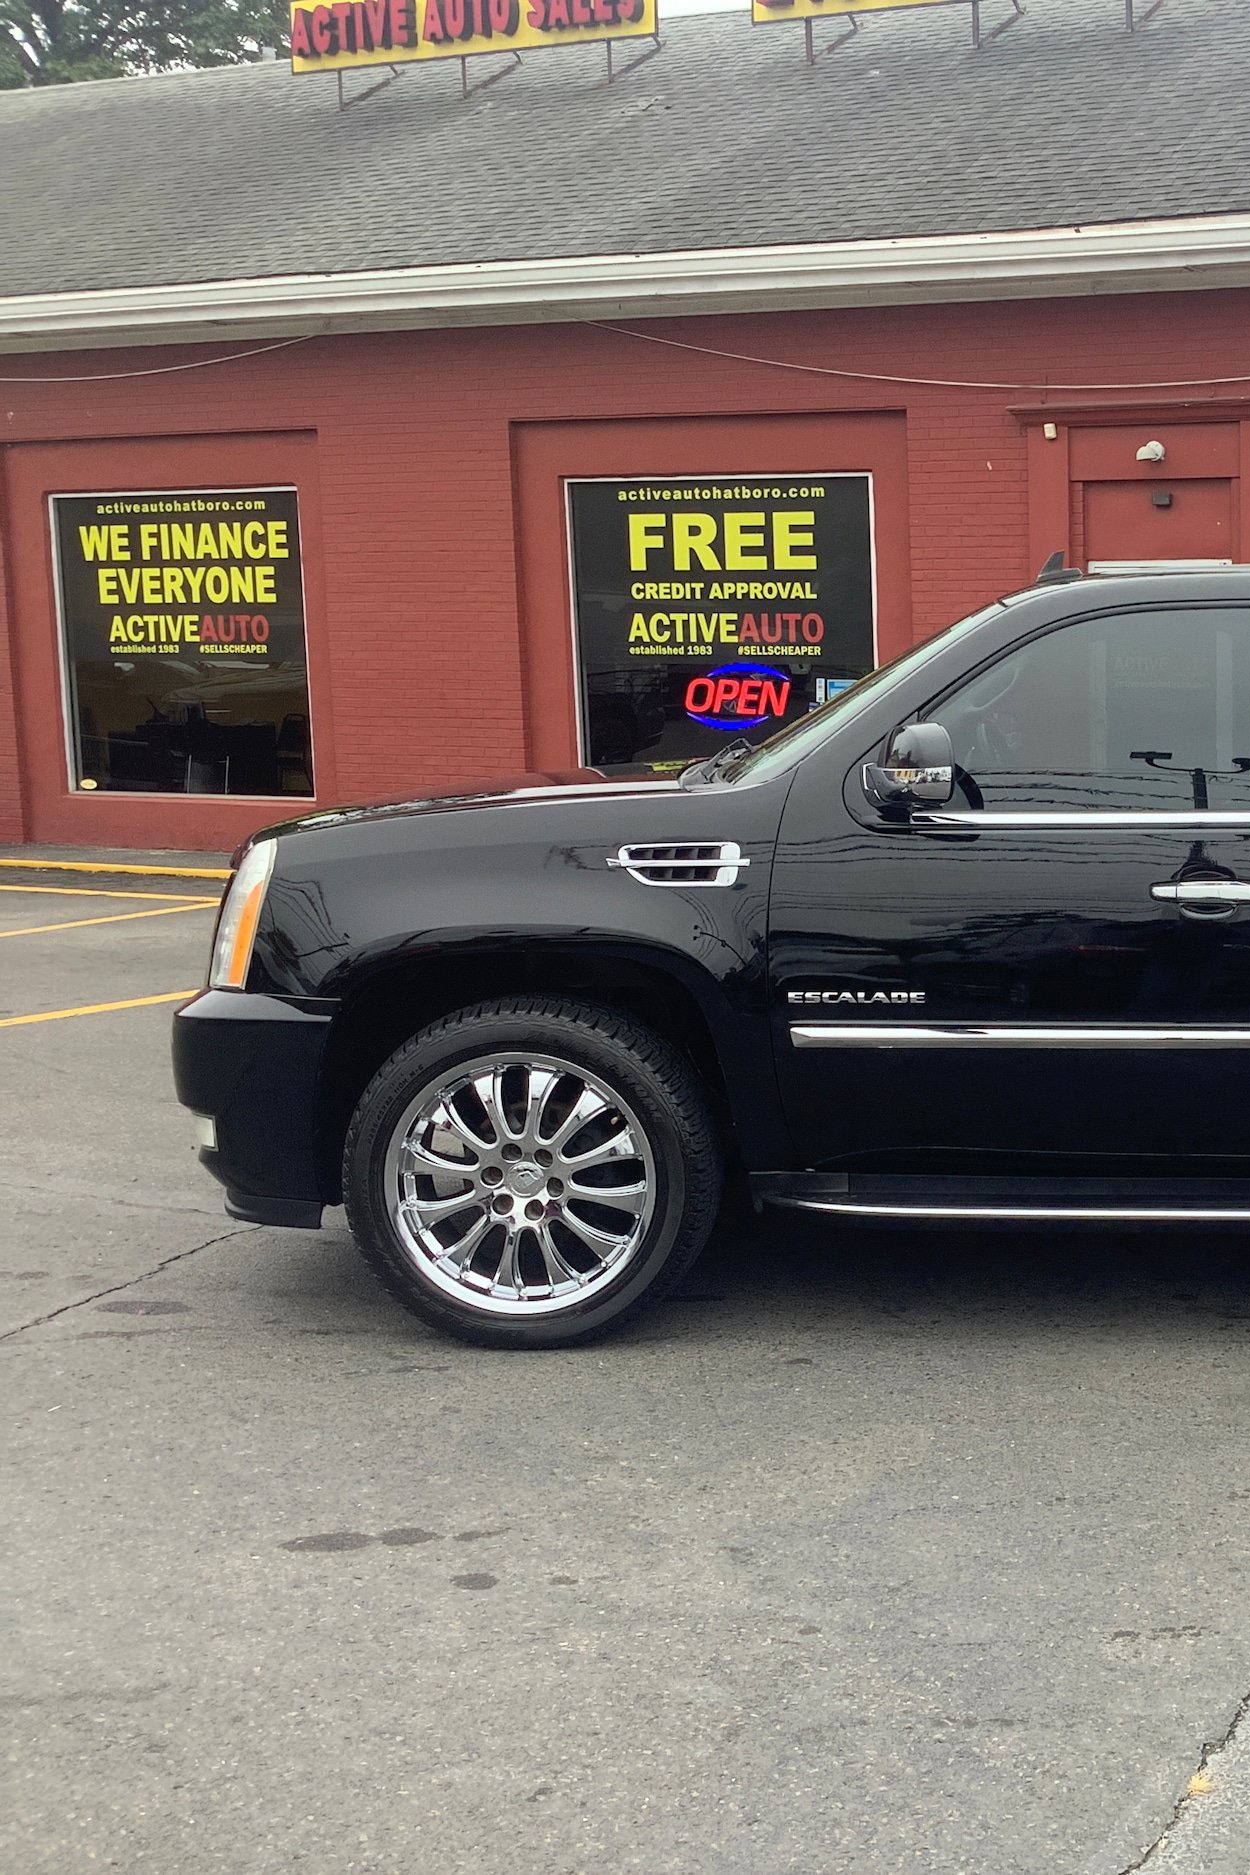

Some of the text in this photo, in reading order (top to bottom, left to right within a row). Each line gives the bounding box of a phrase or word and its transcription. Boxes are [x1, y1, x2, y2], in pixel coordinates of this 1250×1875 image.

[290, 0, 410, 56] ACTIVE
[422, 0, 512, 41] AUTO
[618, 486, 825, 501] activeautohatboro.com
[97, 499, 266, 514] activeautohatboro.com
[79, 521, 289, 561] WE FINANCE
[628, 511, 818, 571] FREE
[98, 566, 277, 604] EVERYONE
[631, 582, 817, 600] CREDIT APPROVAL
[111, 644, 268, 654] established 1983 #SELLSCHEAPER
[629, 645, 822, 656] established 1983 #SELLSCHEAPER
[685, 678, 790, 716] OPEN
[787, 992, 926, 1004] ESCALADE
